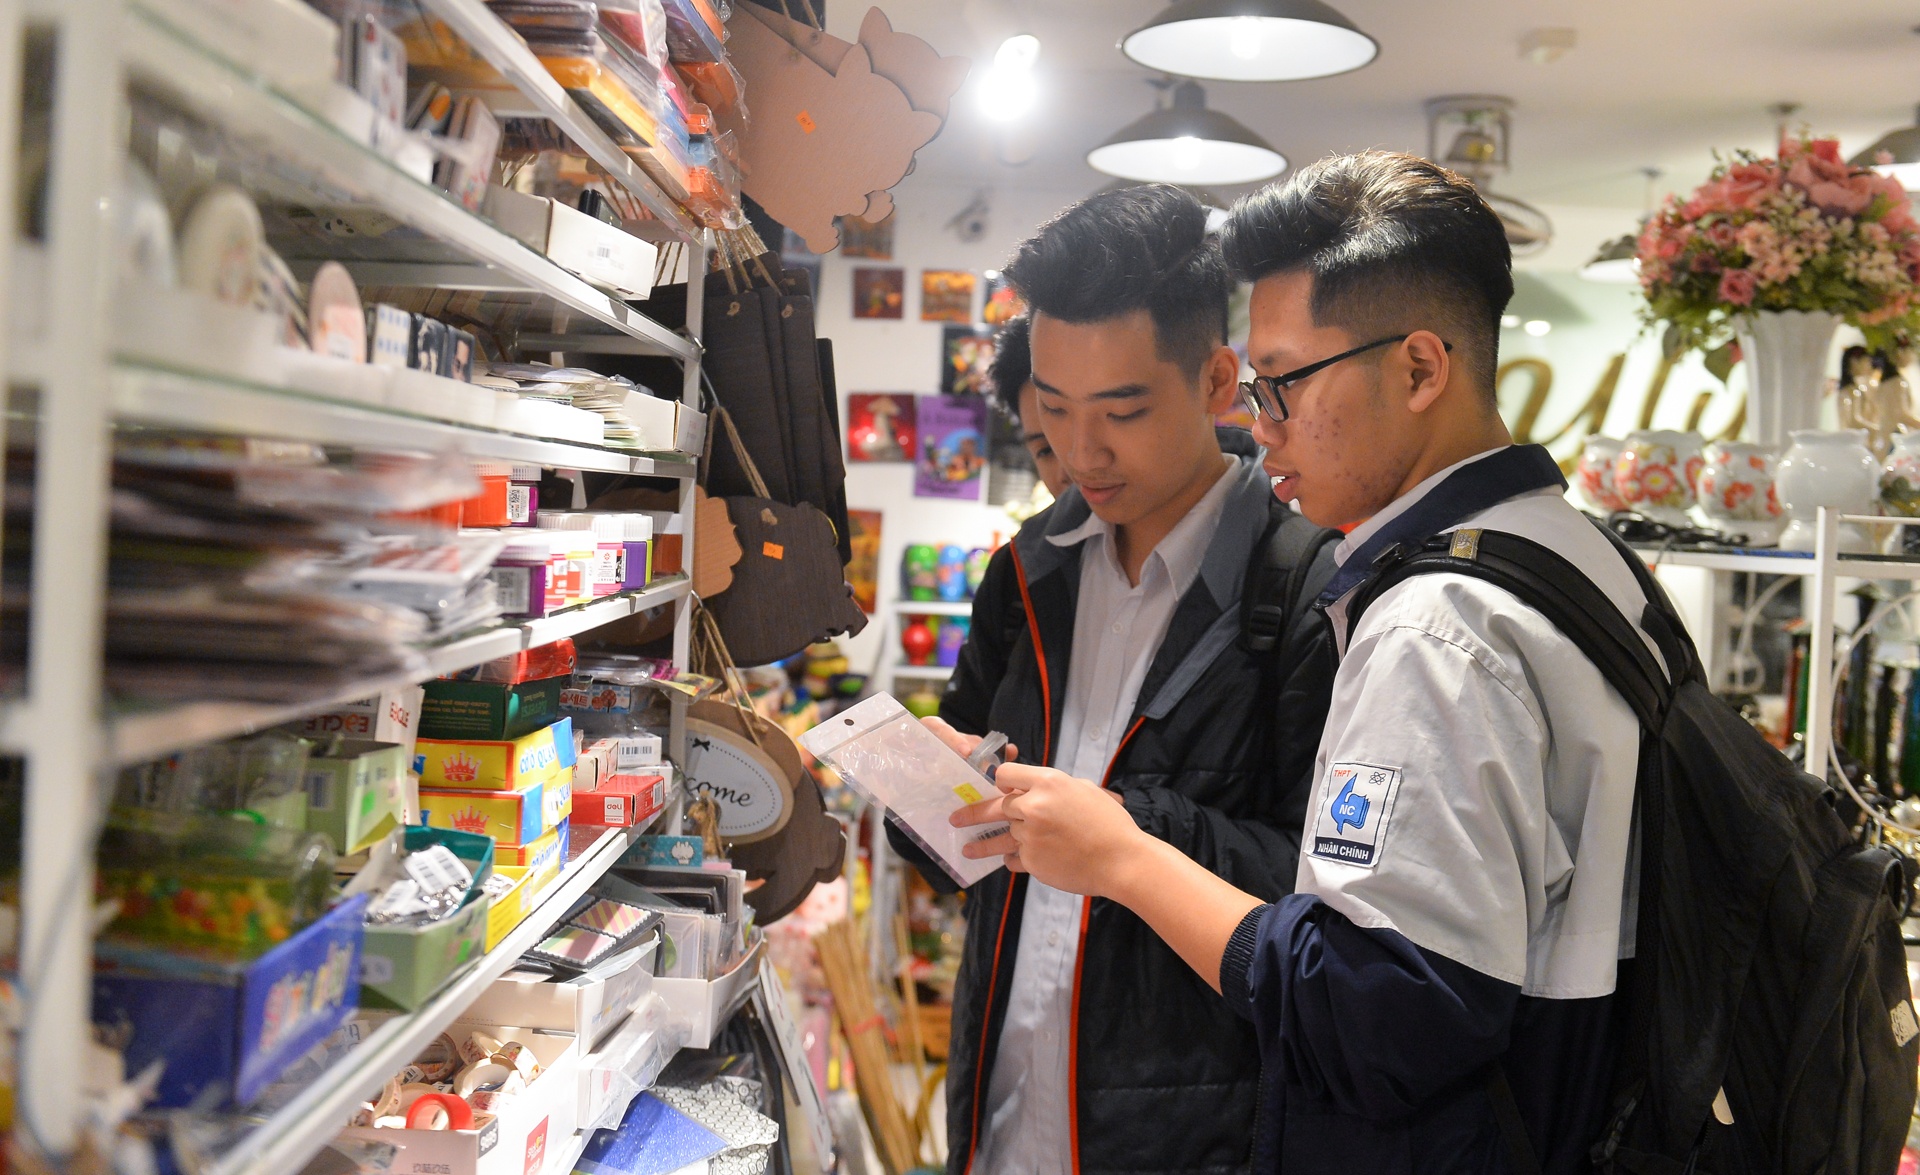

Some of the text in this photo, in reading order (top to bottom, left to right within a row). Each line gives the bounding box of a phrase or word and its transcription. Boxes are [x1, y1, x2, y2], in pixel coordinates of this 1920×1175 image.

[1333, 769, 1351, 778] THPT
[606, 803, 623, 811] deli
[1338, 804, 1356, 816] NC
[1317, 841, 1369, 860] NHÂN CHÍNH
